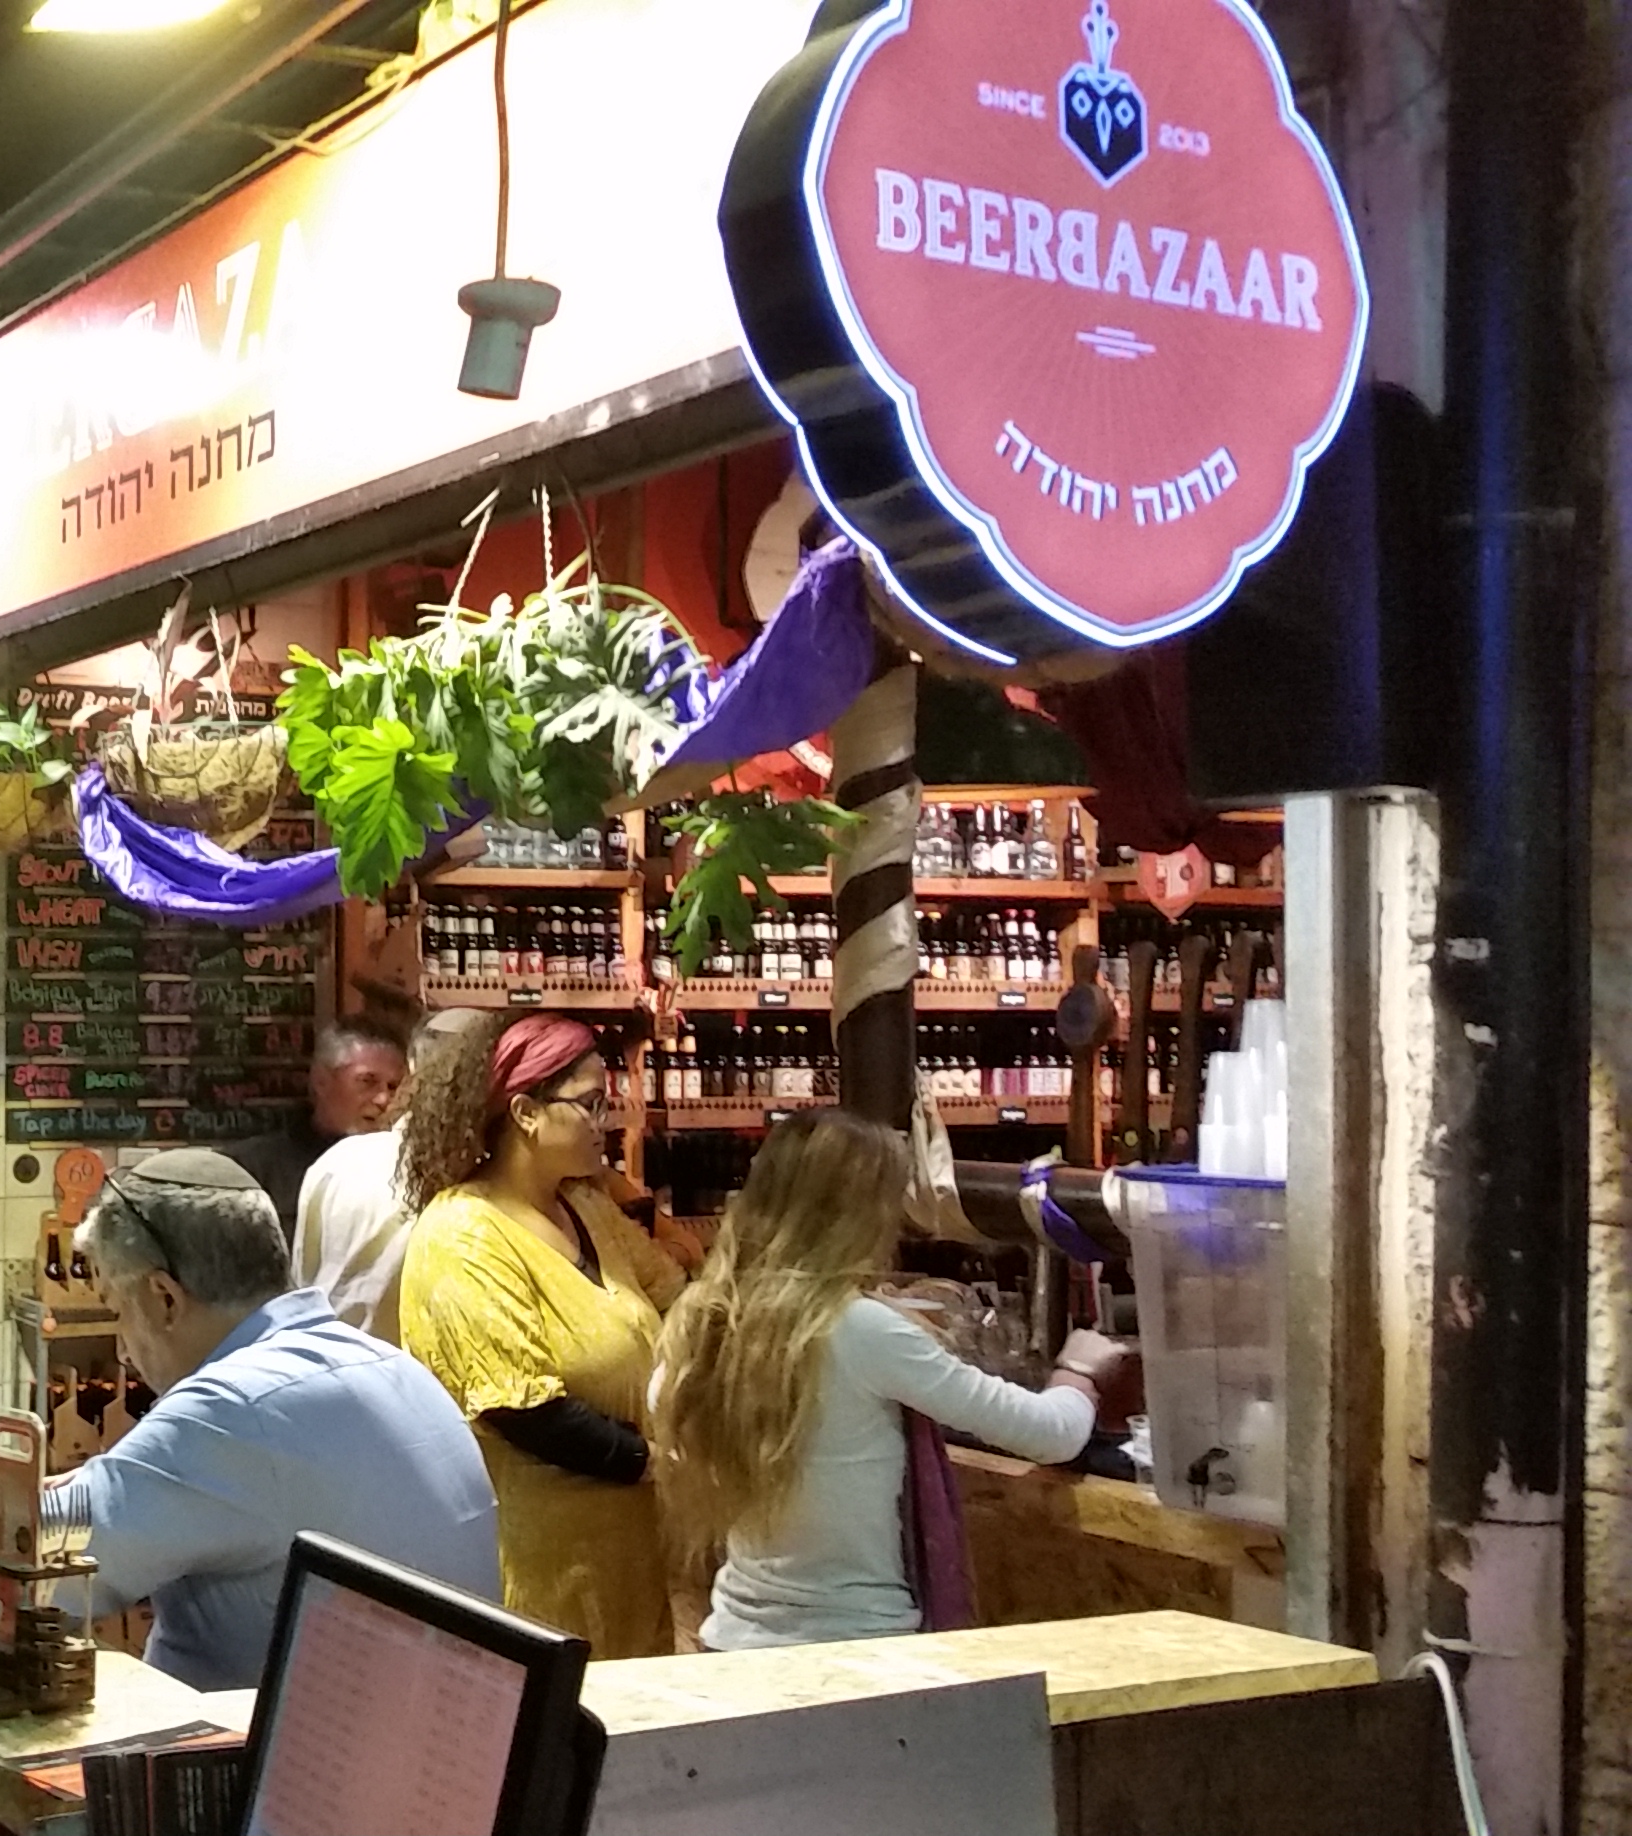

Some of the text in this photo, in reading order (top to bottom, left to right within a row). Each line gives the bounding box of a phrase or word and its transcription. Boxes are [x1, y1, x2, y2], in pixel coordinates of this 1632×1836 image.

[977, 81, 1211, 157] SINCE 2013
[874, 166, 1324, 332] BEERBAZAAR
[169, 409, 276, 500] מחנה
[993, 419, 1240, 526] מחנה יהודה
[60, 459, 154, 544] יהודה
[17, 896, 106, 928] WHEAT
[13, 1108, 148, 1136] Tap of the day
